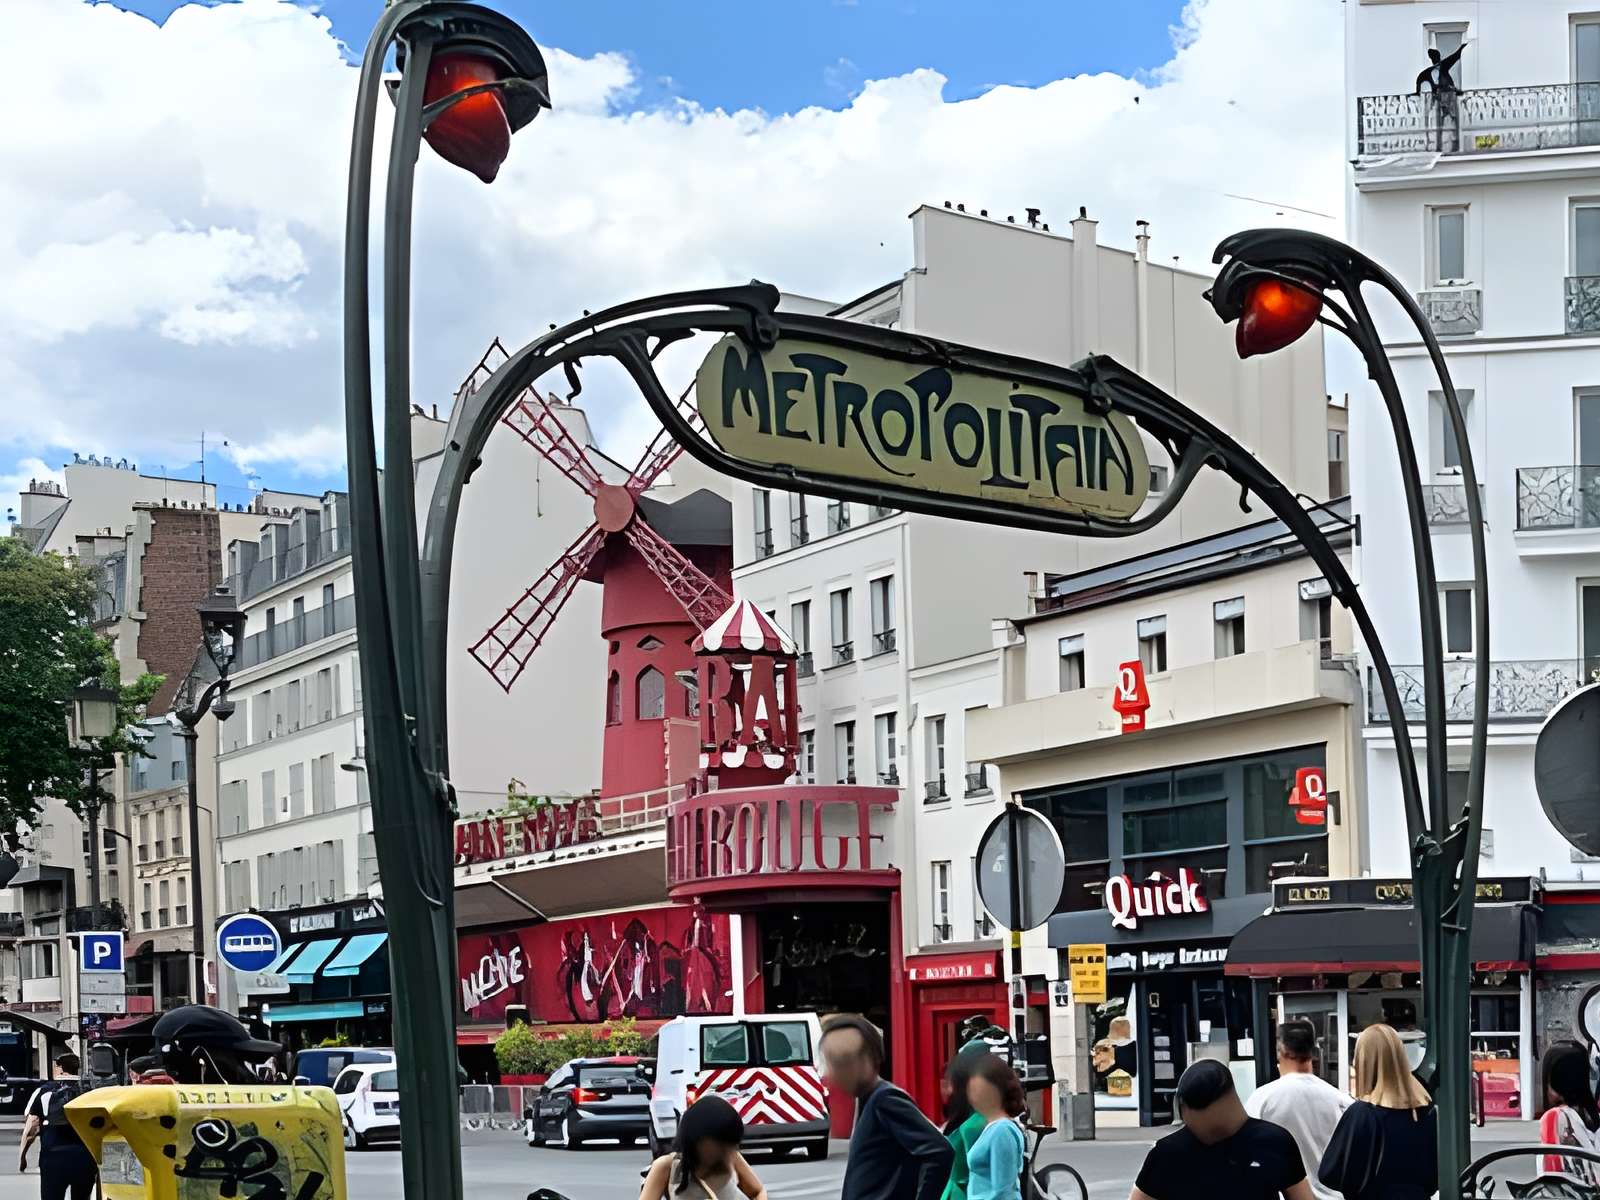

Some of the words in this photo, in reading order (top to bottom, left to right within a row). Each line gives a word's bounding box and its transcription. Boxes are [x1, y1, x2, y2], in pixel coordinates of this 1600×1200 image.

[721, 345, 1135, 498] METROPOLITAIN
[1105, 867, 1208, 929] Quick
[92, 941, 112, 964] P
